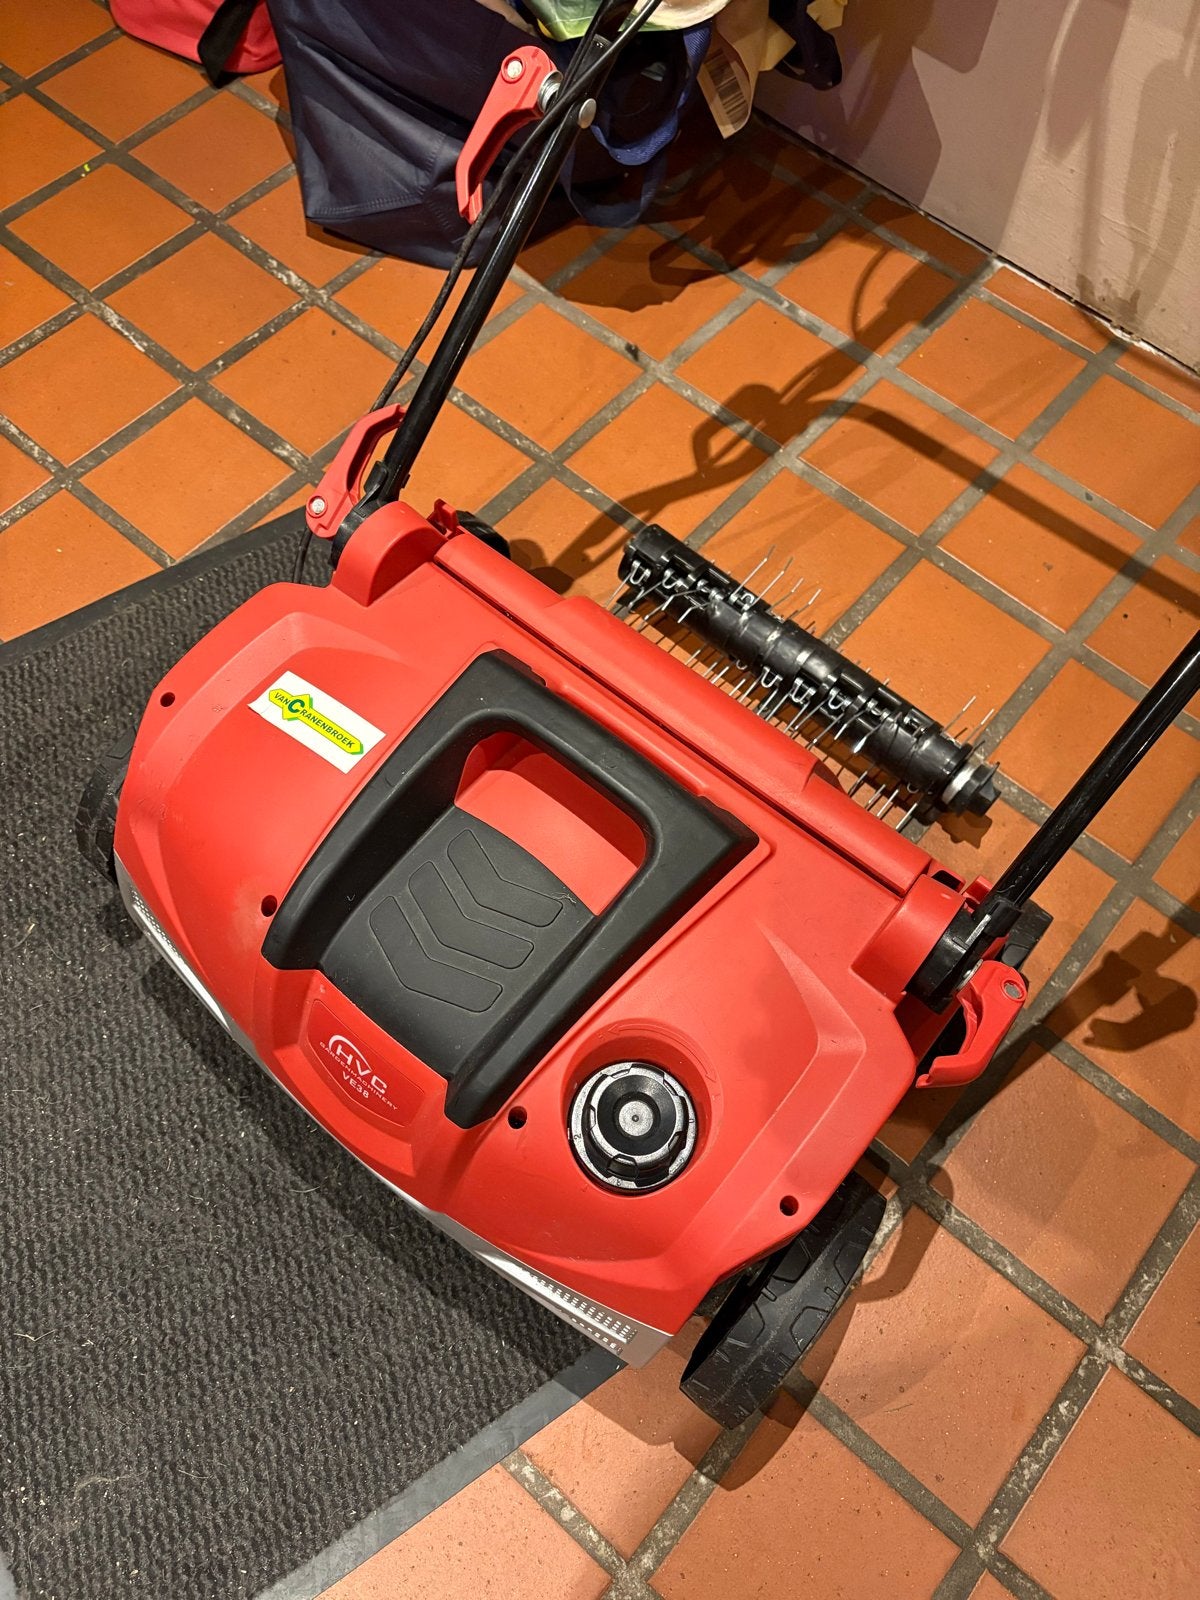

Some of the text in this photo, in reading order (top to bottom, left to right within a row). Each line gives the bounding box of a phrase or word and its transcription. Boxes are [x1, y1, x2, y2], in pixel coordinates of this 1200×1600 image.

[274, 692, 355, 749] VAN CRANENBROEK
[336, 1044, 388, 1095] HVC
[342, 1070, 370, 1099] VE38
